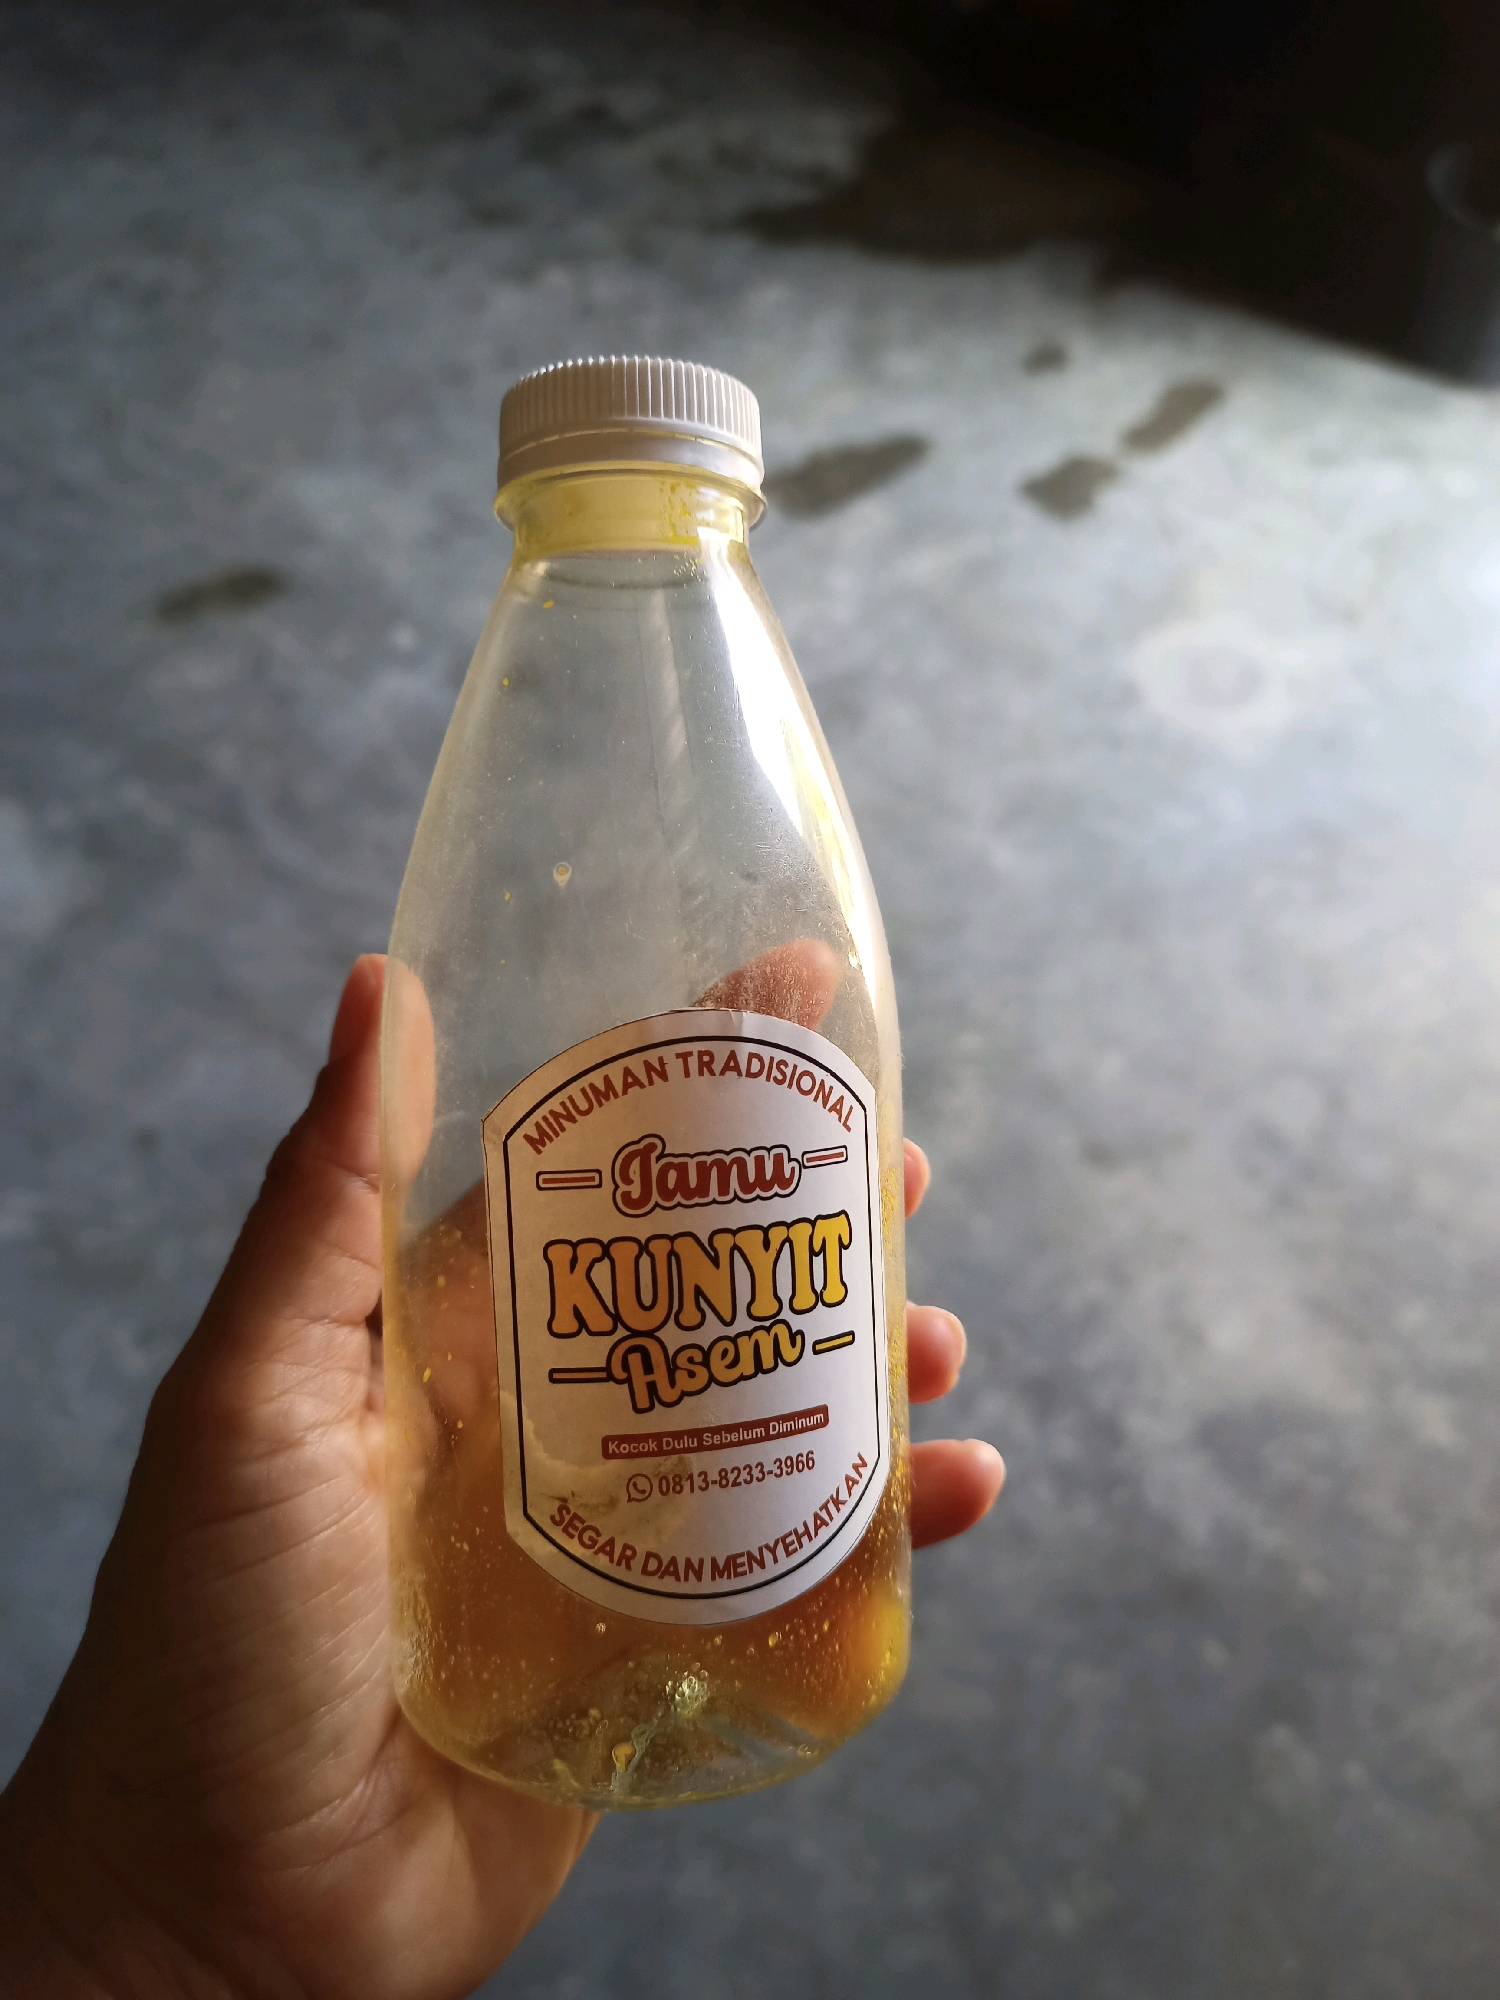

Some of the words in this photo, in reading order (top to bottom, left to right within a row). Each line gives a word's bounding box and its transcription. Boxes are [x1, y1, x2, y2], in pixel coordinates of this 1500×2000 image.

[522, 1055, 669, 1156] MINUMAN
[675, 1049, 853, 1133] TRADISIONAL
[612, 1135, 801, 1217] Jamu
[543, 1210, 852, 1339] KUNYIT
[606, 1319, 806, 1414] Asem
[608, 1437, 658, 1455] Kocok
[662, 1434, 699, 1451] Dulu
[702, 1424, 766, 1446] Sebelum
[769, 1411, 825, 1434] Diminum
[658, 1449, 816, 1497] 0813-8233-3966
[549, 1502, 638, 1571] SEGAR
[640, 1553, 704, 1583] DAN
[710, 1451, 869, 1582] MENYEHATKAN
